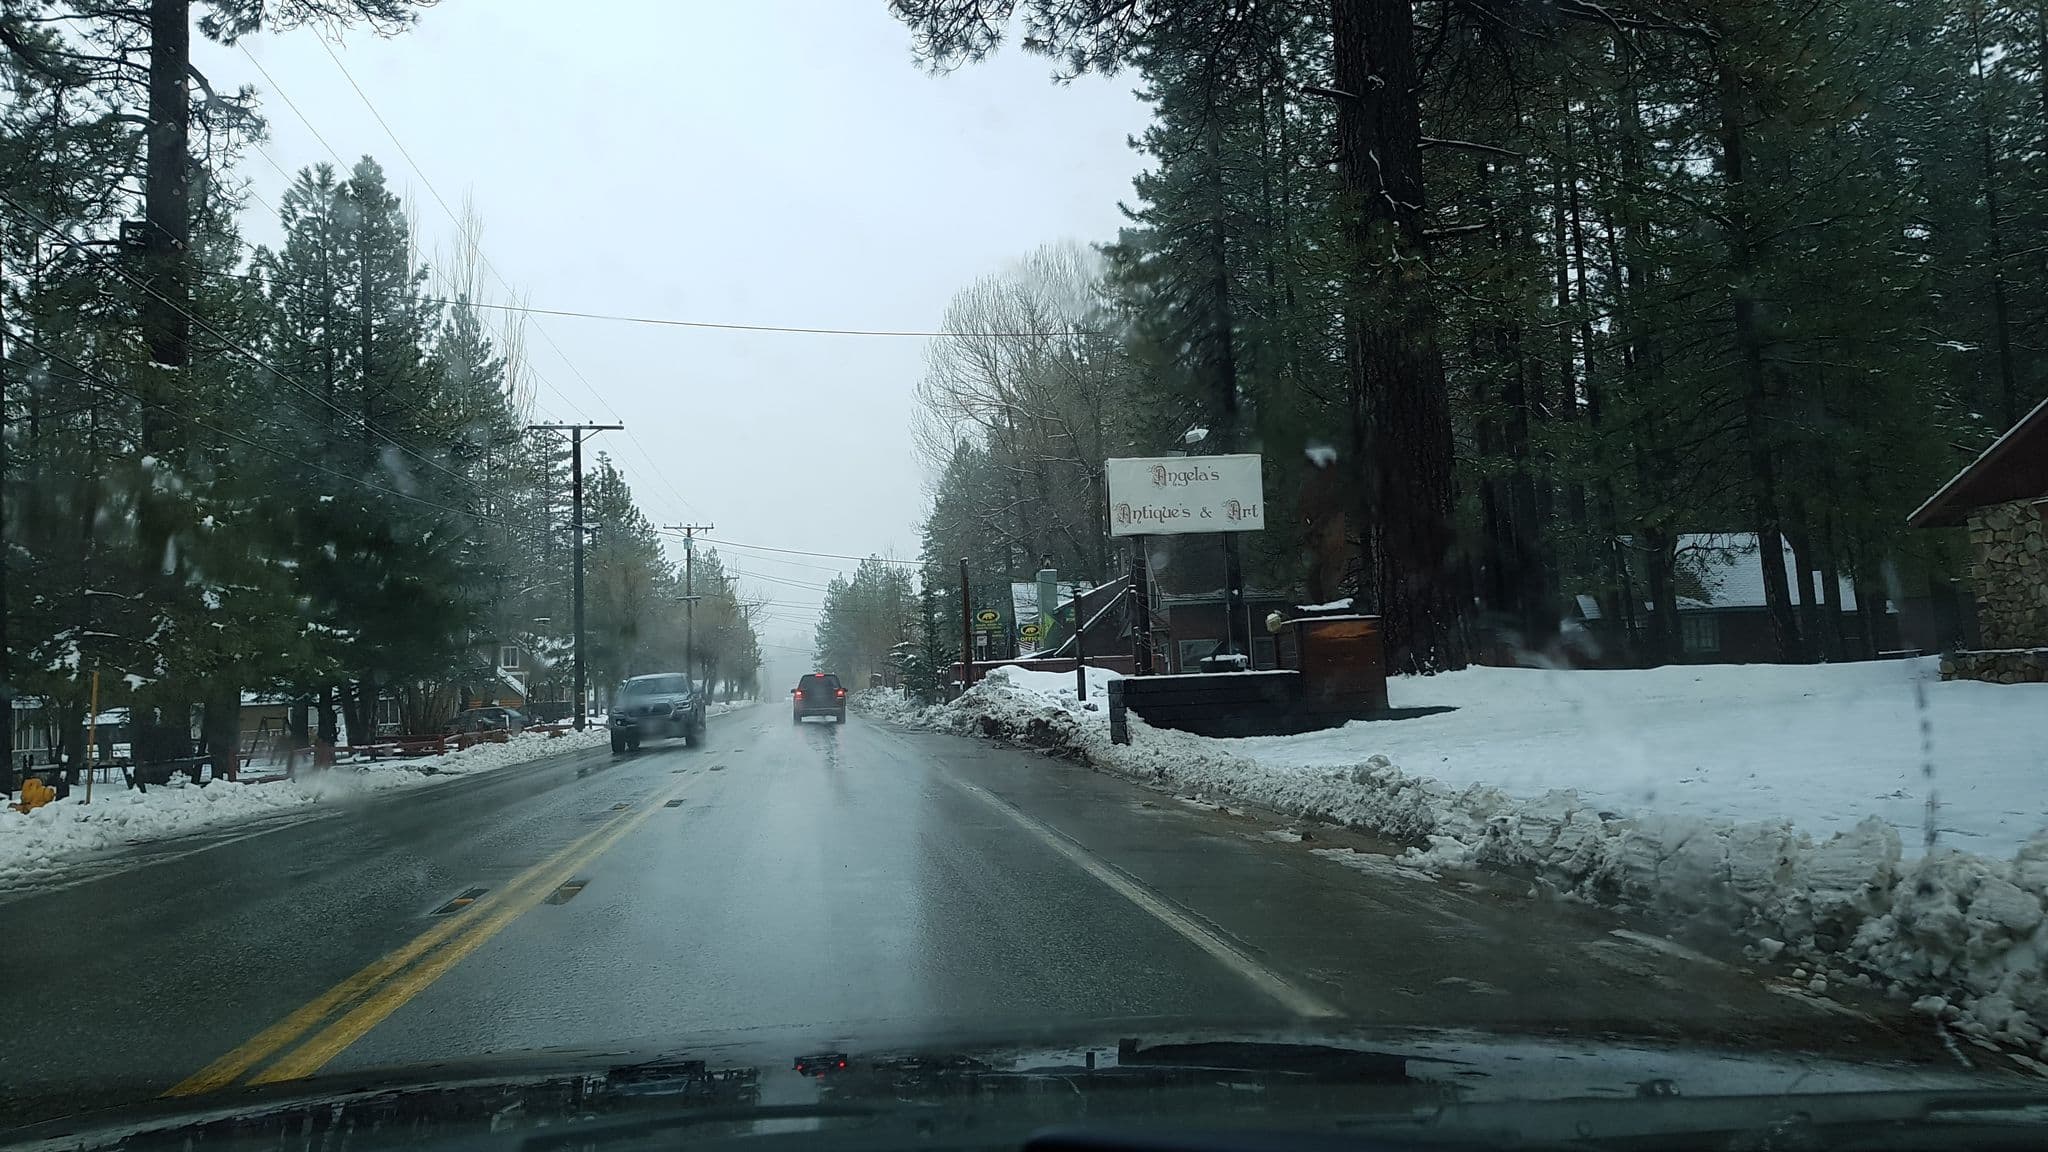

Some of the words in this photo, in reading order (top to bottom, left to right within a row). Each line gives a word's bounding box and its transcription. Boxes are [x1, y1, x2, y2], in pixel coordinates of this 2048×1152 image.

[1150, 465, 1220, 488] Angela's
[1116, 503, 1191, 525] Antique's
[1199, 506, 1212, 519] &
[1225, 500, 1259, 522] Art
